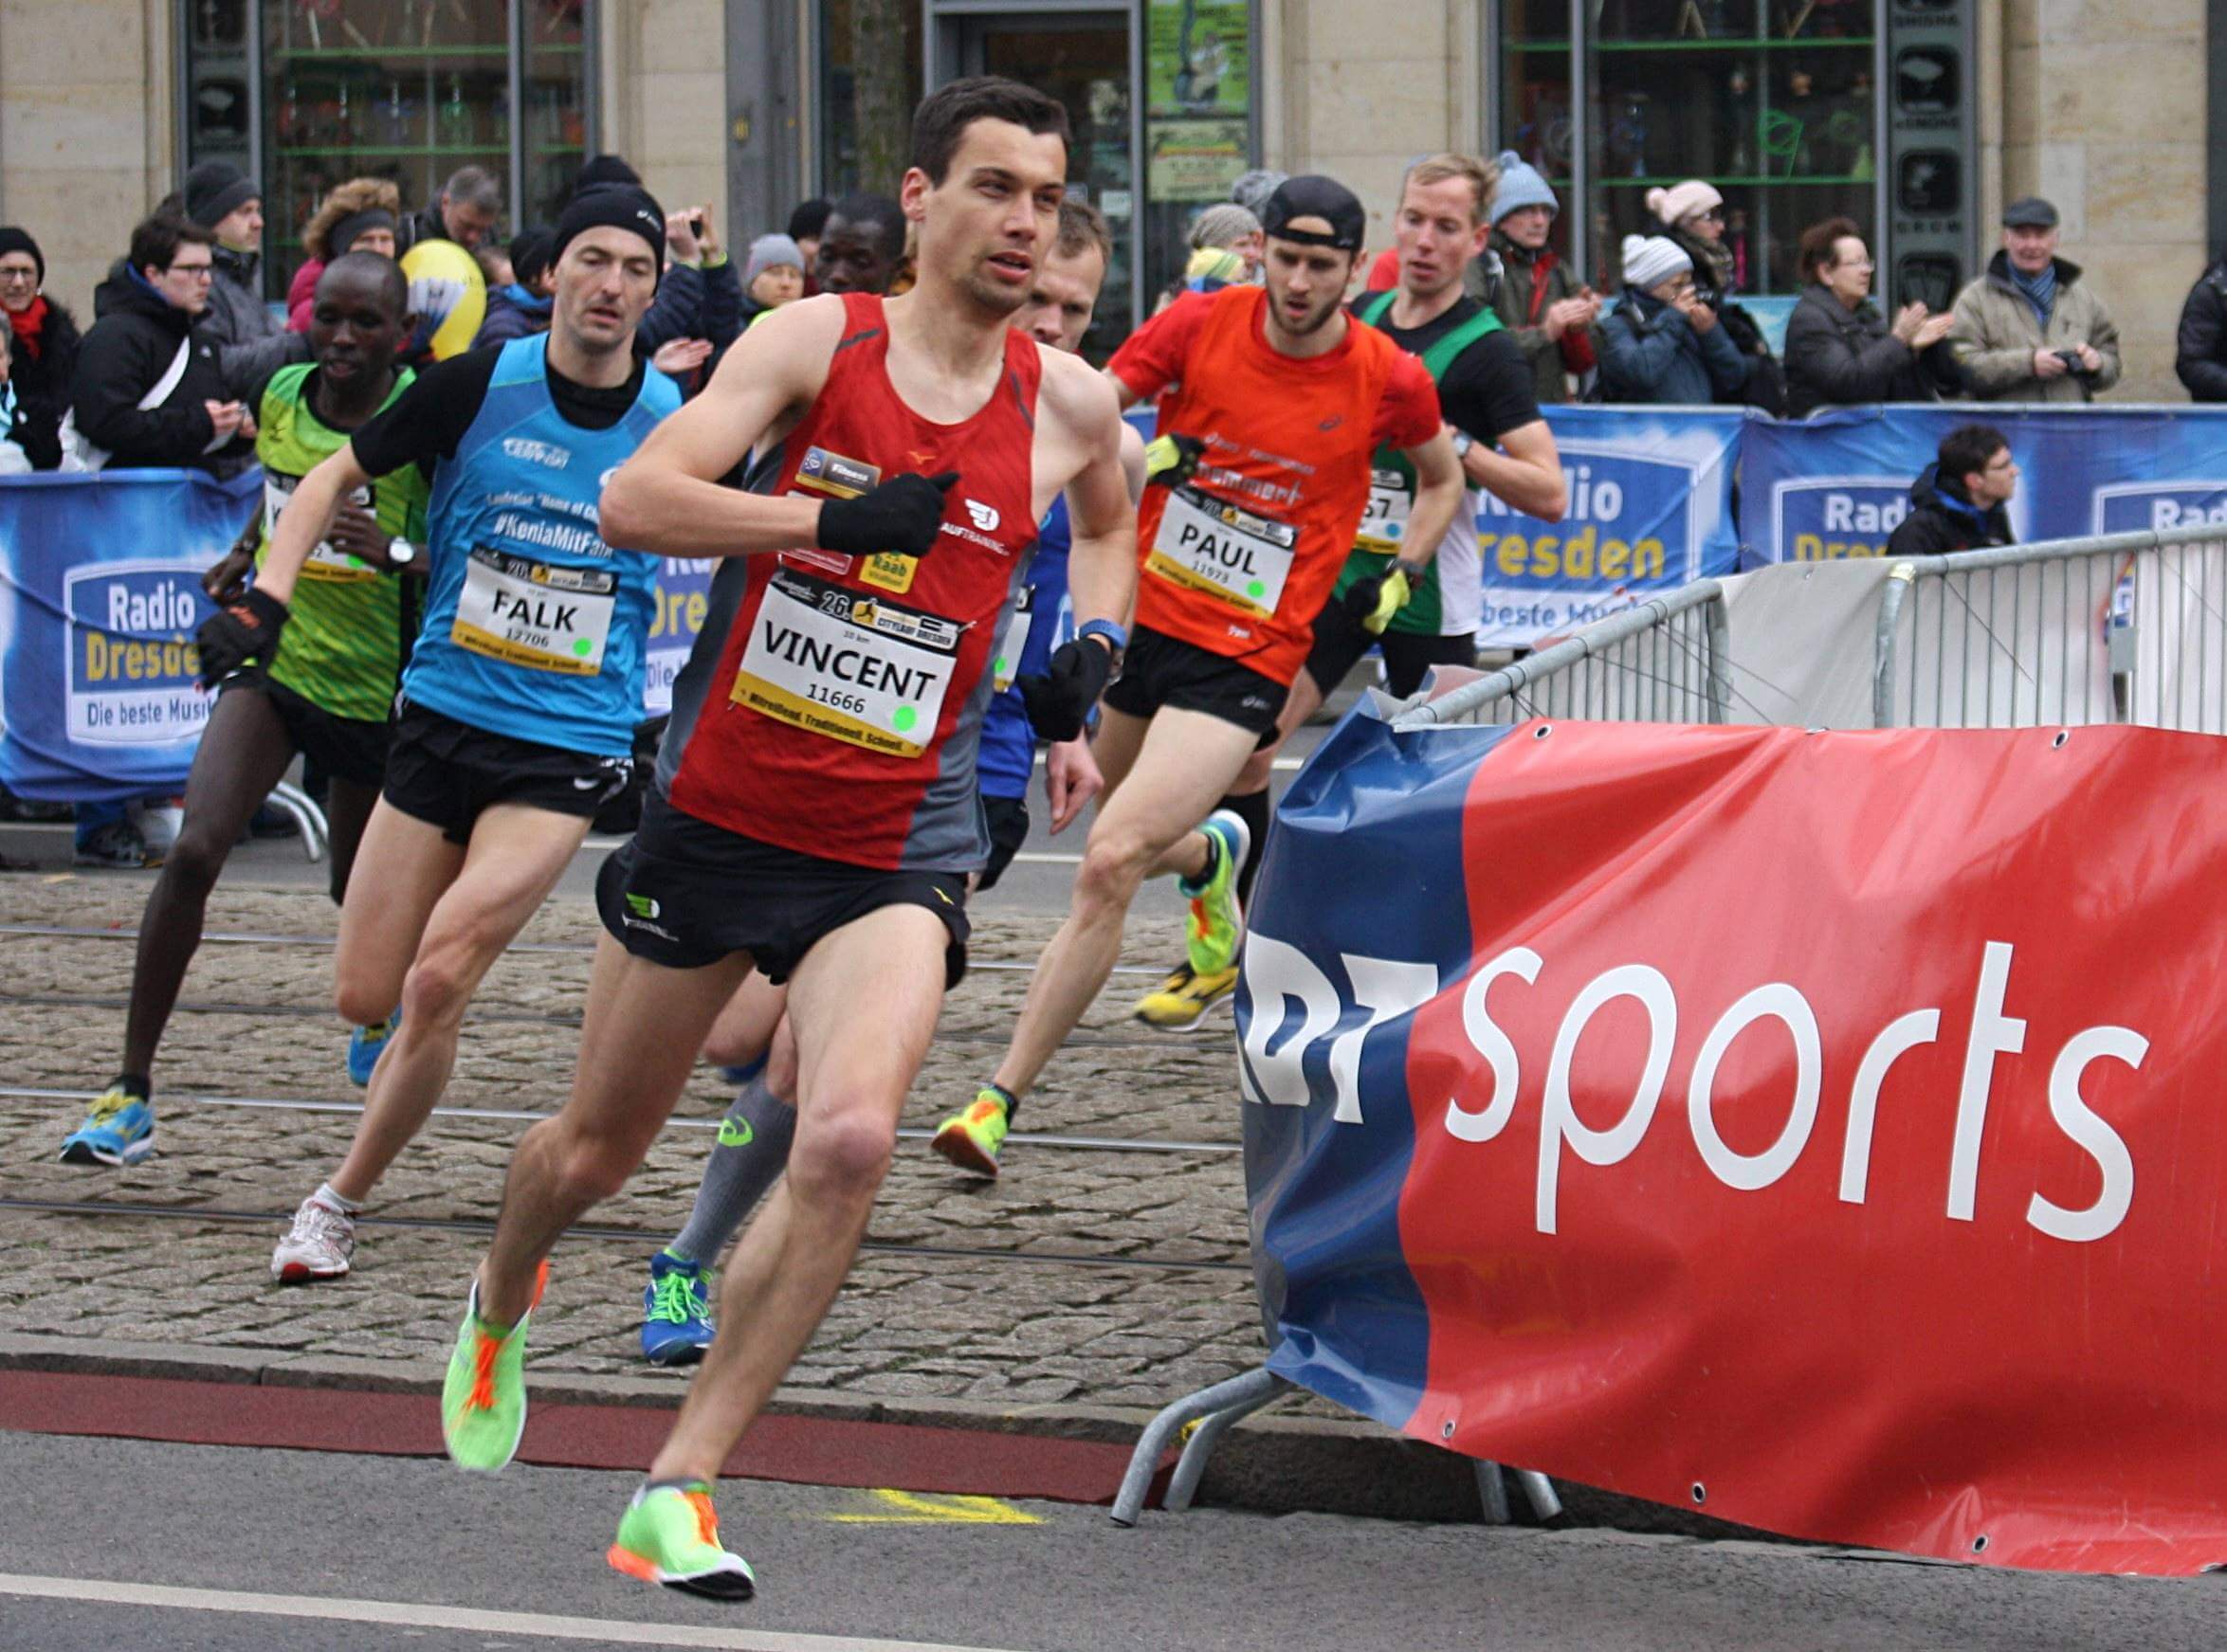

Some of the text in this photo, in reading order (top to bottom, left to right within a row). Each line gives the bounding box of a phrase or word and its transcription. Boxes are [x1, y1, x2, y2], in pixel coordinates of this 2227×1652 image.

[1825, 493, 1908, 533] Rad
[1179, 522, 1258, 576] PAUL
[1477, 525, 1665, 580] resden
[108, 579, 196, 632] Radio
[492, 589, 579, 633] FALK
[85, 630, 201, 681] Dresde
[764, 619, 939, 701] VINCENT
[87, 701, 114, 727] Die
[119, 700, 162, 725] beste
[806, 682, 867, 714] 11666
[1445, 940, 2150, 1243] sports
